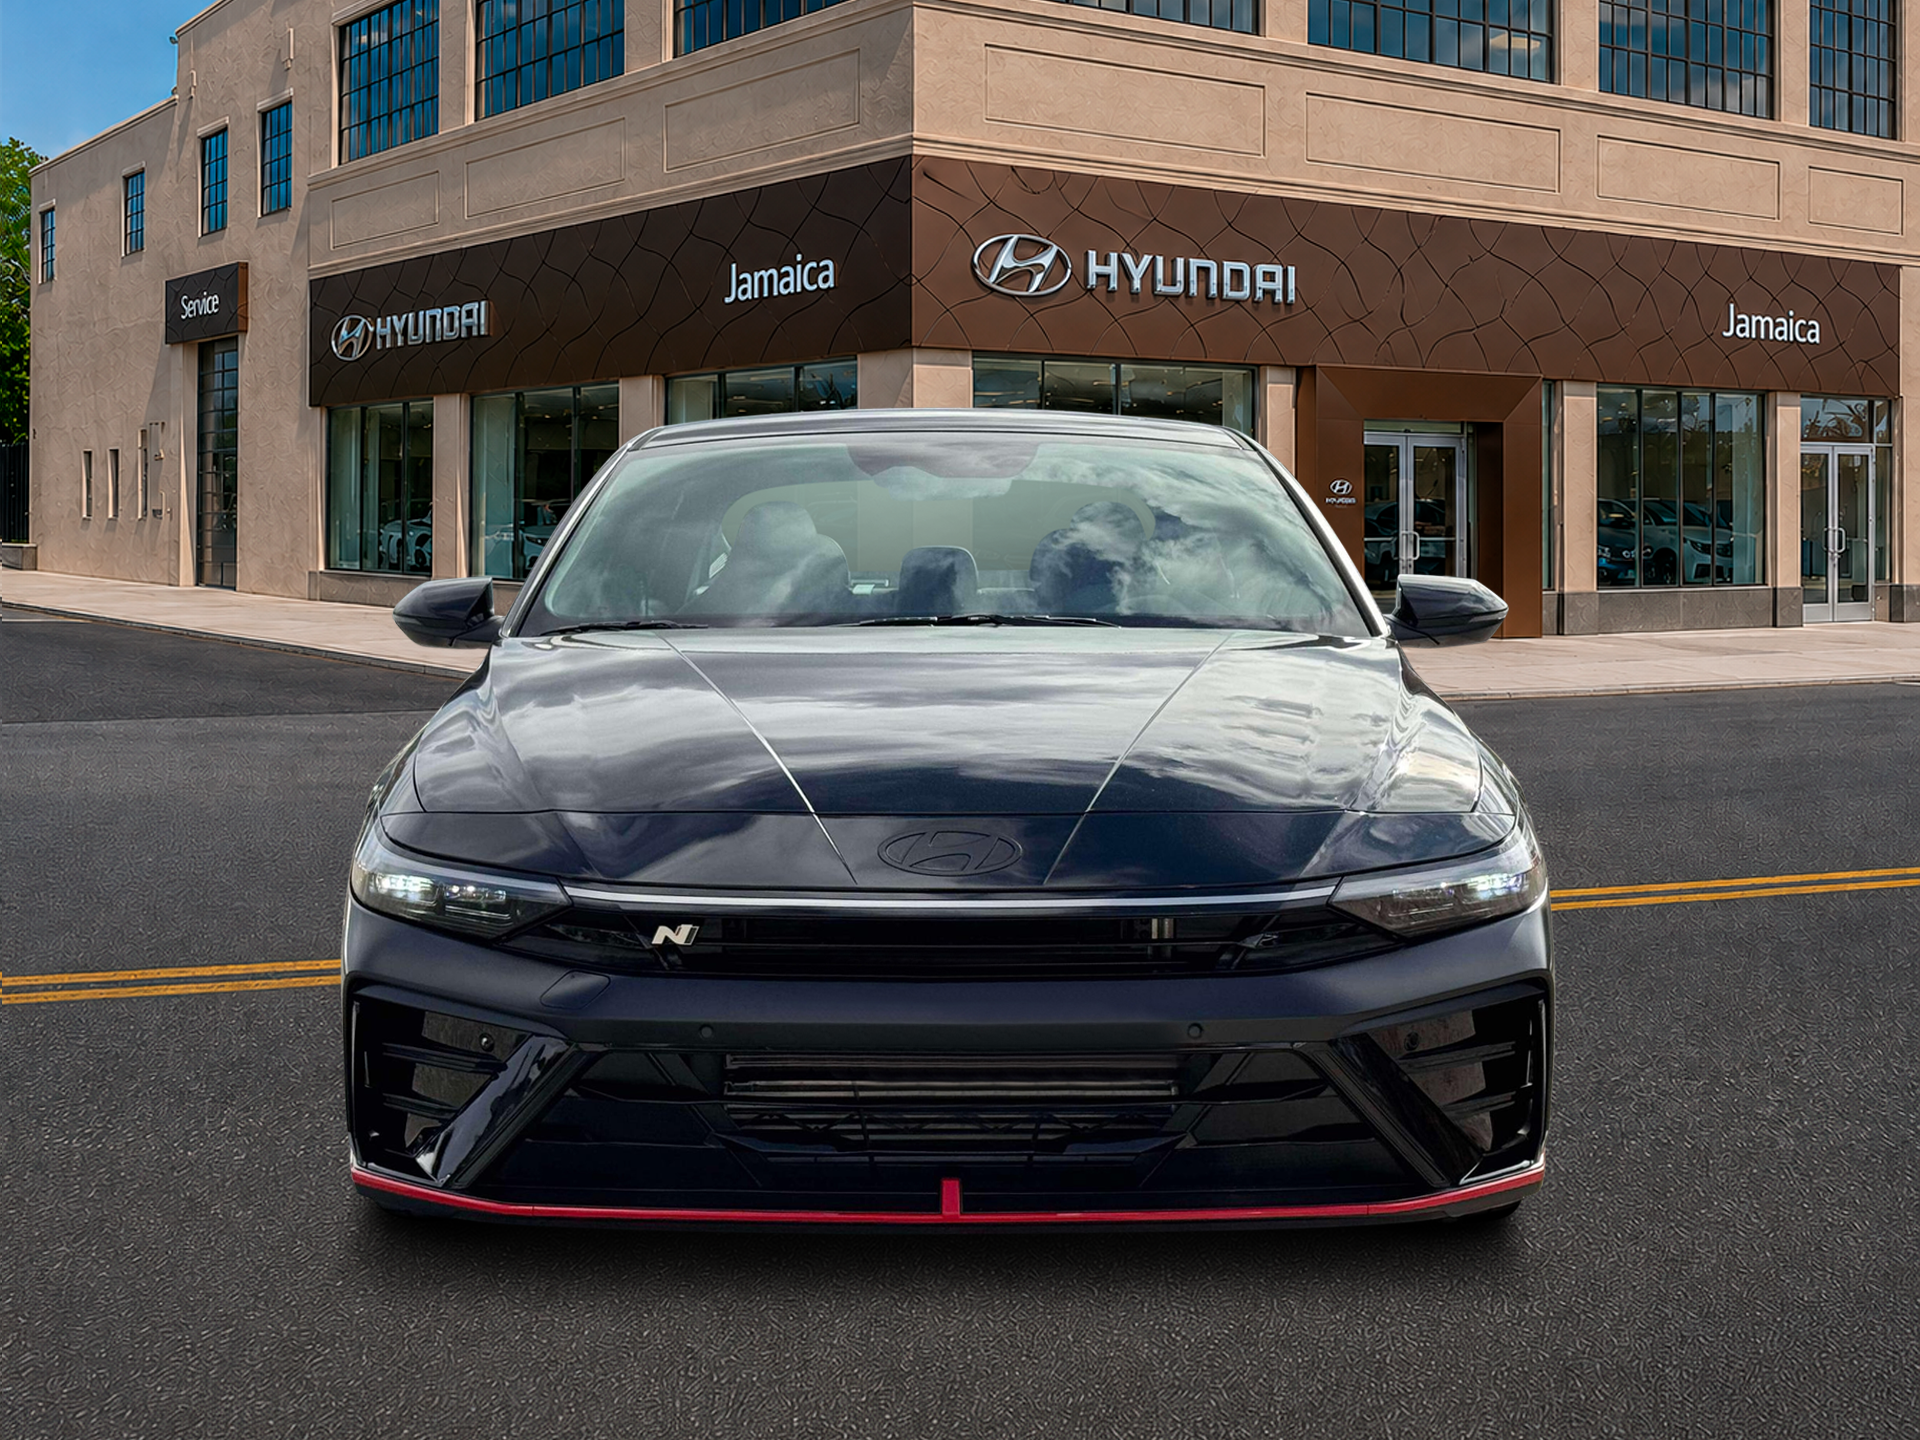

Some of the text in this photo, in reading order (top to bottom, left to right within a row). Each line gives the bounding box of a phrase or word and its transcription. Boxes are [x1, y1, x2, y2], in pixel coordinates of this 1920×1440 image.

[724, 253, 836, 304] Jamaica
[1084, 249, 1296, 304] HYUNDAI
[180, 291, 220, 319] Service
[375, 300, 489, 350] HYUNDAI
[1722, 303, 1820, 344] Jamaica
